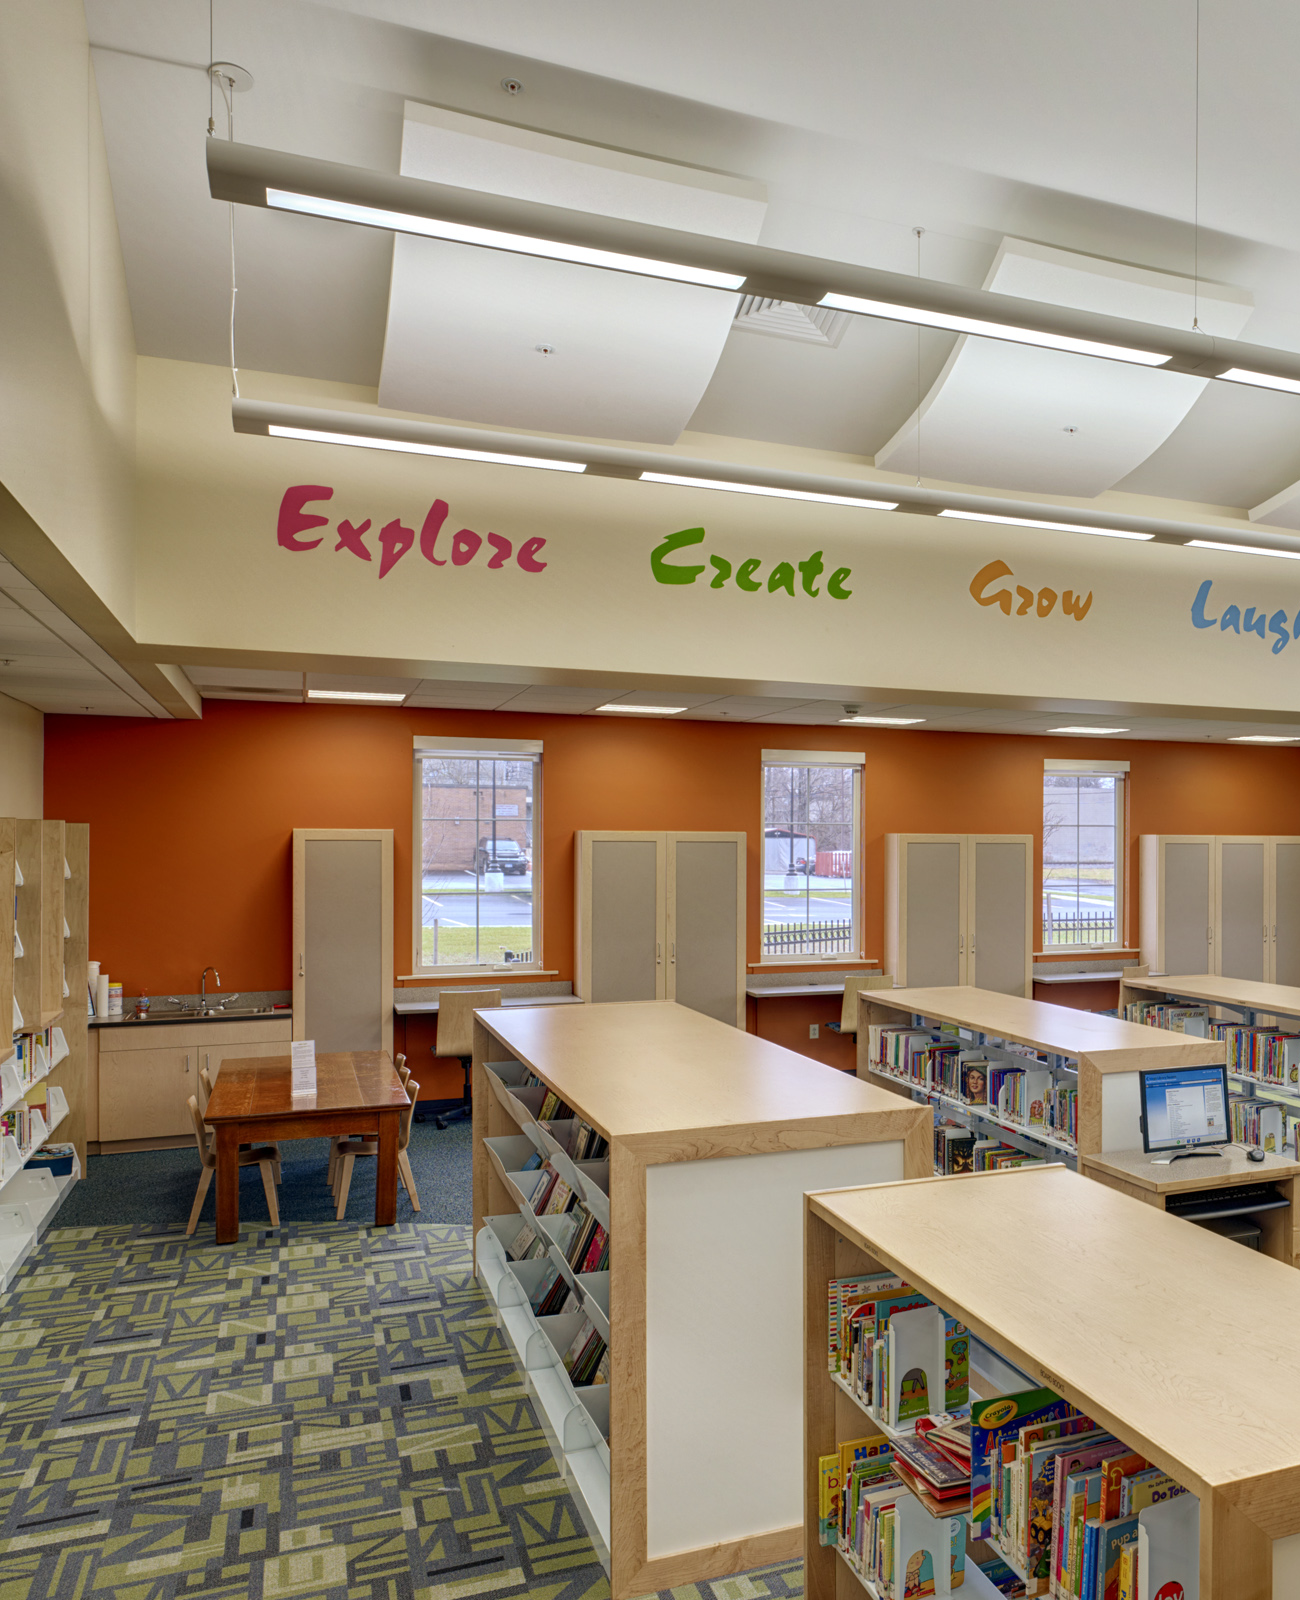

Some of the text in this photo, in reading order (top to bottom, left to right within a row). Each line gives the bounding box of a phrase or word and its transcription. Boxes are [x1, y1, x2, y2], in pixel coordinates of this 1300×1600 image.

[276, 484, 548, 580] Explore
[650, 526, 853, 600] Create
[968, 558, 1094, 622] Grow
[1053, 1377, 1065, 1393] BOOKS
[984, 1404, 1012, 1420] Crayola
[854, 1443, 893, 1460] Hap
[1152, 1485, 1190, 1503] Do Tou
[1111, 1533, 1130, 1550] Pup
